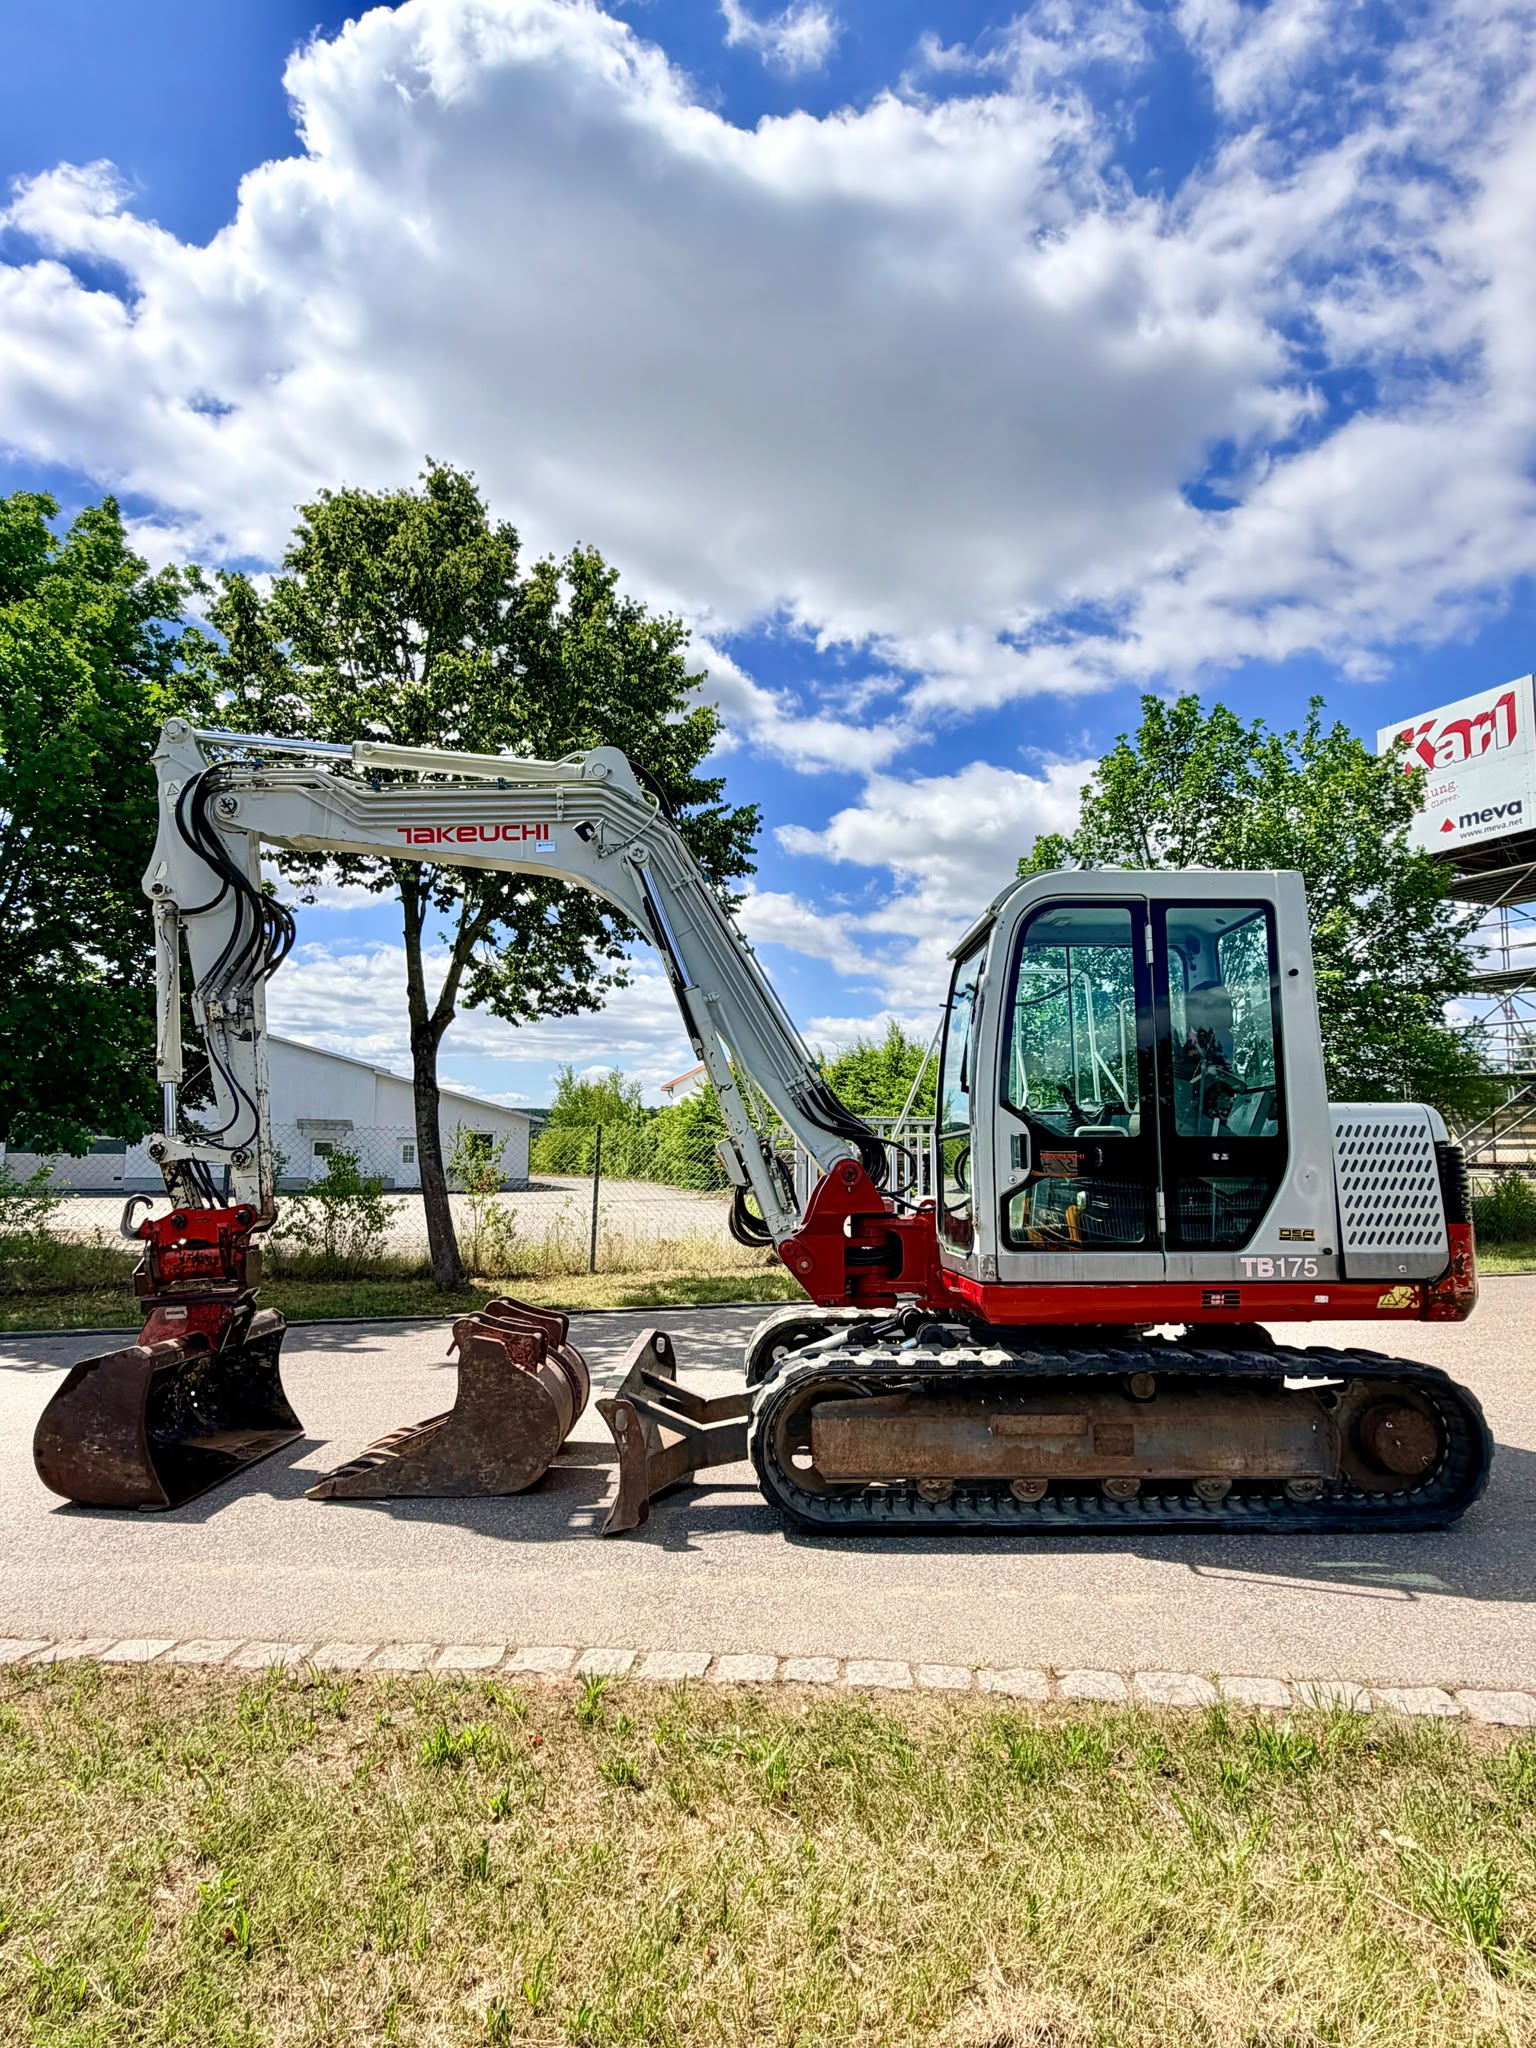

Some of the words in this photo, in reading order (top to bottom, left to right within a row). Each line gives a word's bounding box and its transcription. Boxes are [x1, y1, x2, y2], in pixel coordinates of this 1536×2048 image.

[1399, 691, 1517, 774] Karl
[1459, 800, 1522, 828] meva
[397, 824, 549, 844] TAKEUCHI
[1460, 818, 1523, 839] www.meva.net
[1240, 1257, 1319, 1278] TB175
